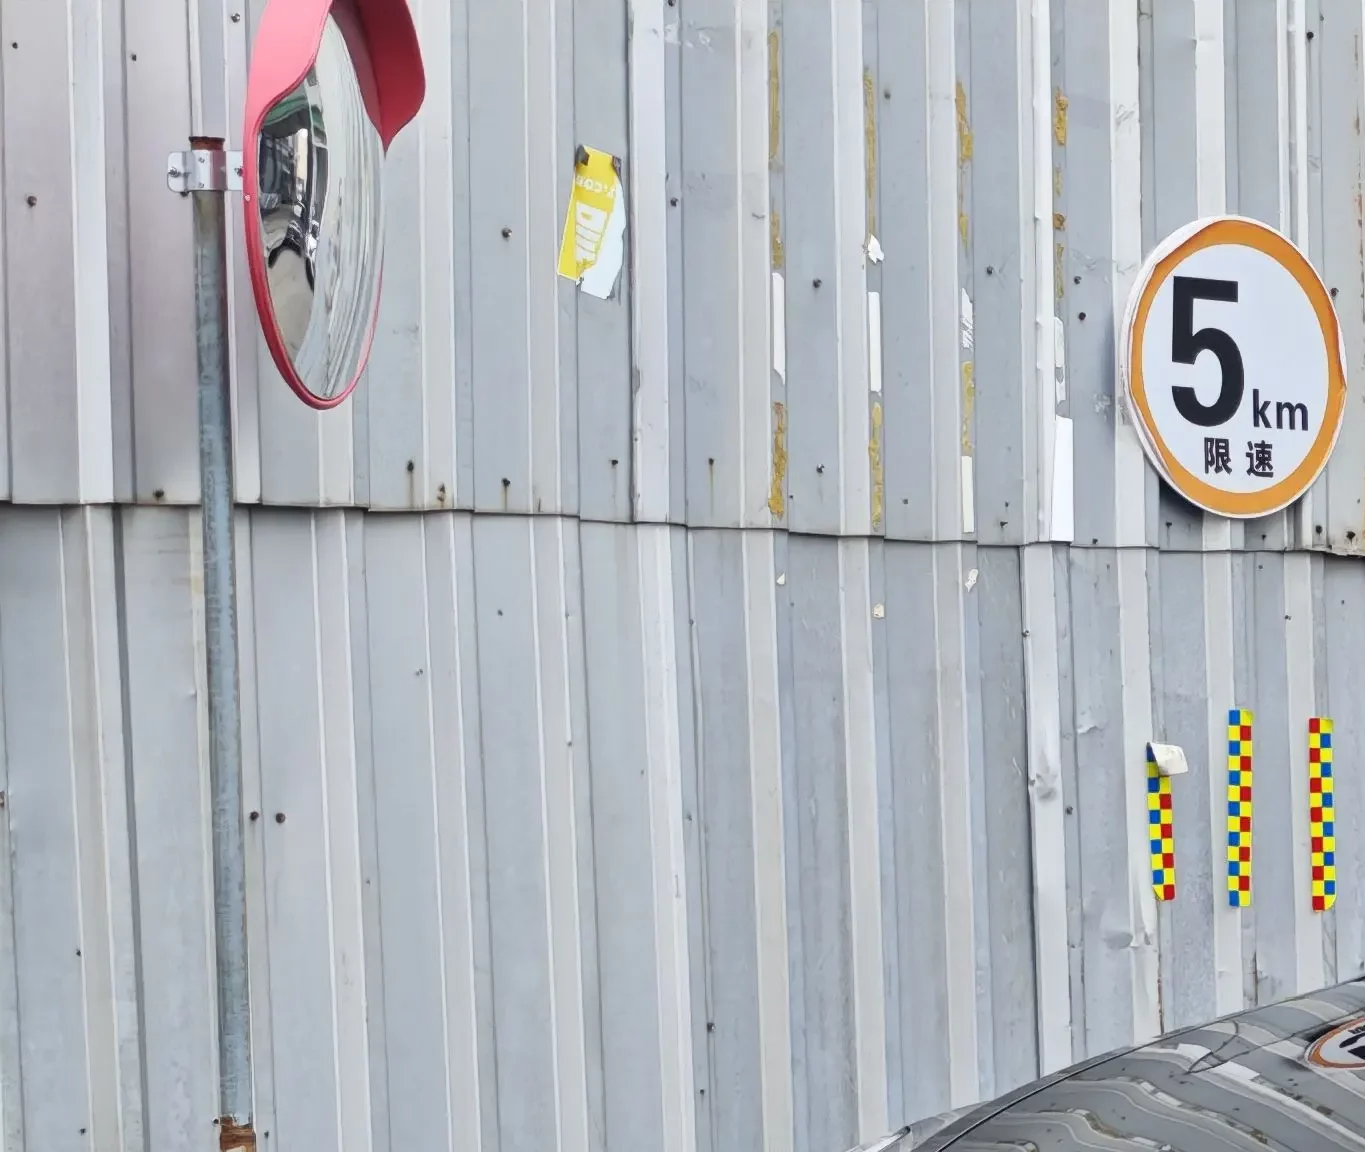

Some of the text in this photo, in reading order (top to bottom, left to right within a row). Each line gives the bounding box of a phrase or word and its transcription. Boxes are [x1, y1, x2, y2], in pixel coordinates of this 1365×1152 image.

[1171, 275, 1309, 431] 5 km
[1203, 436, 1274, 478] 限速
